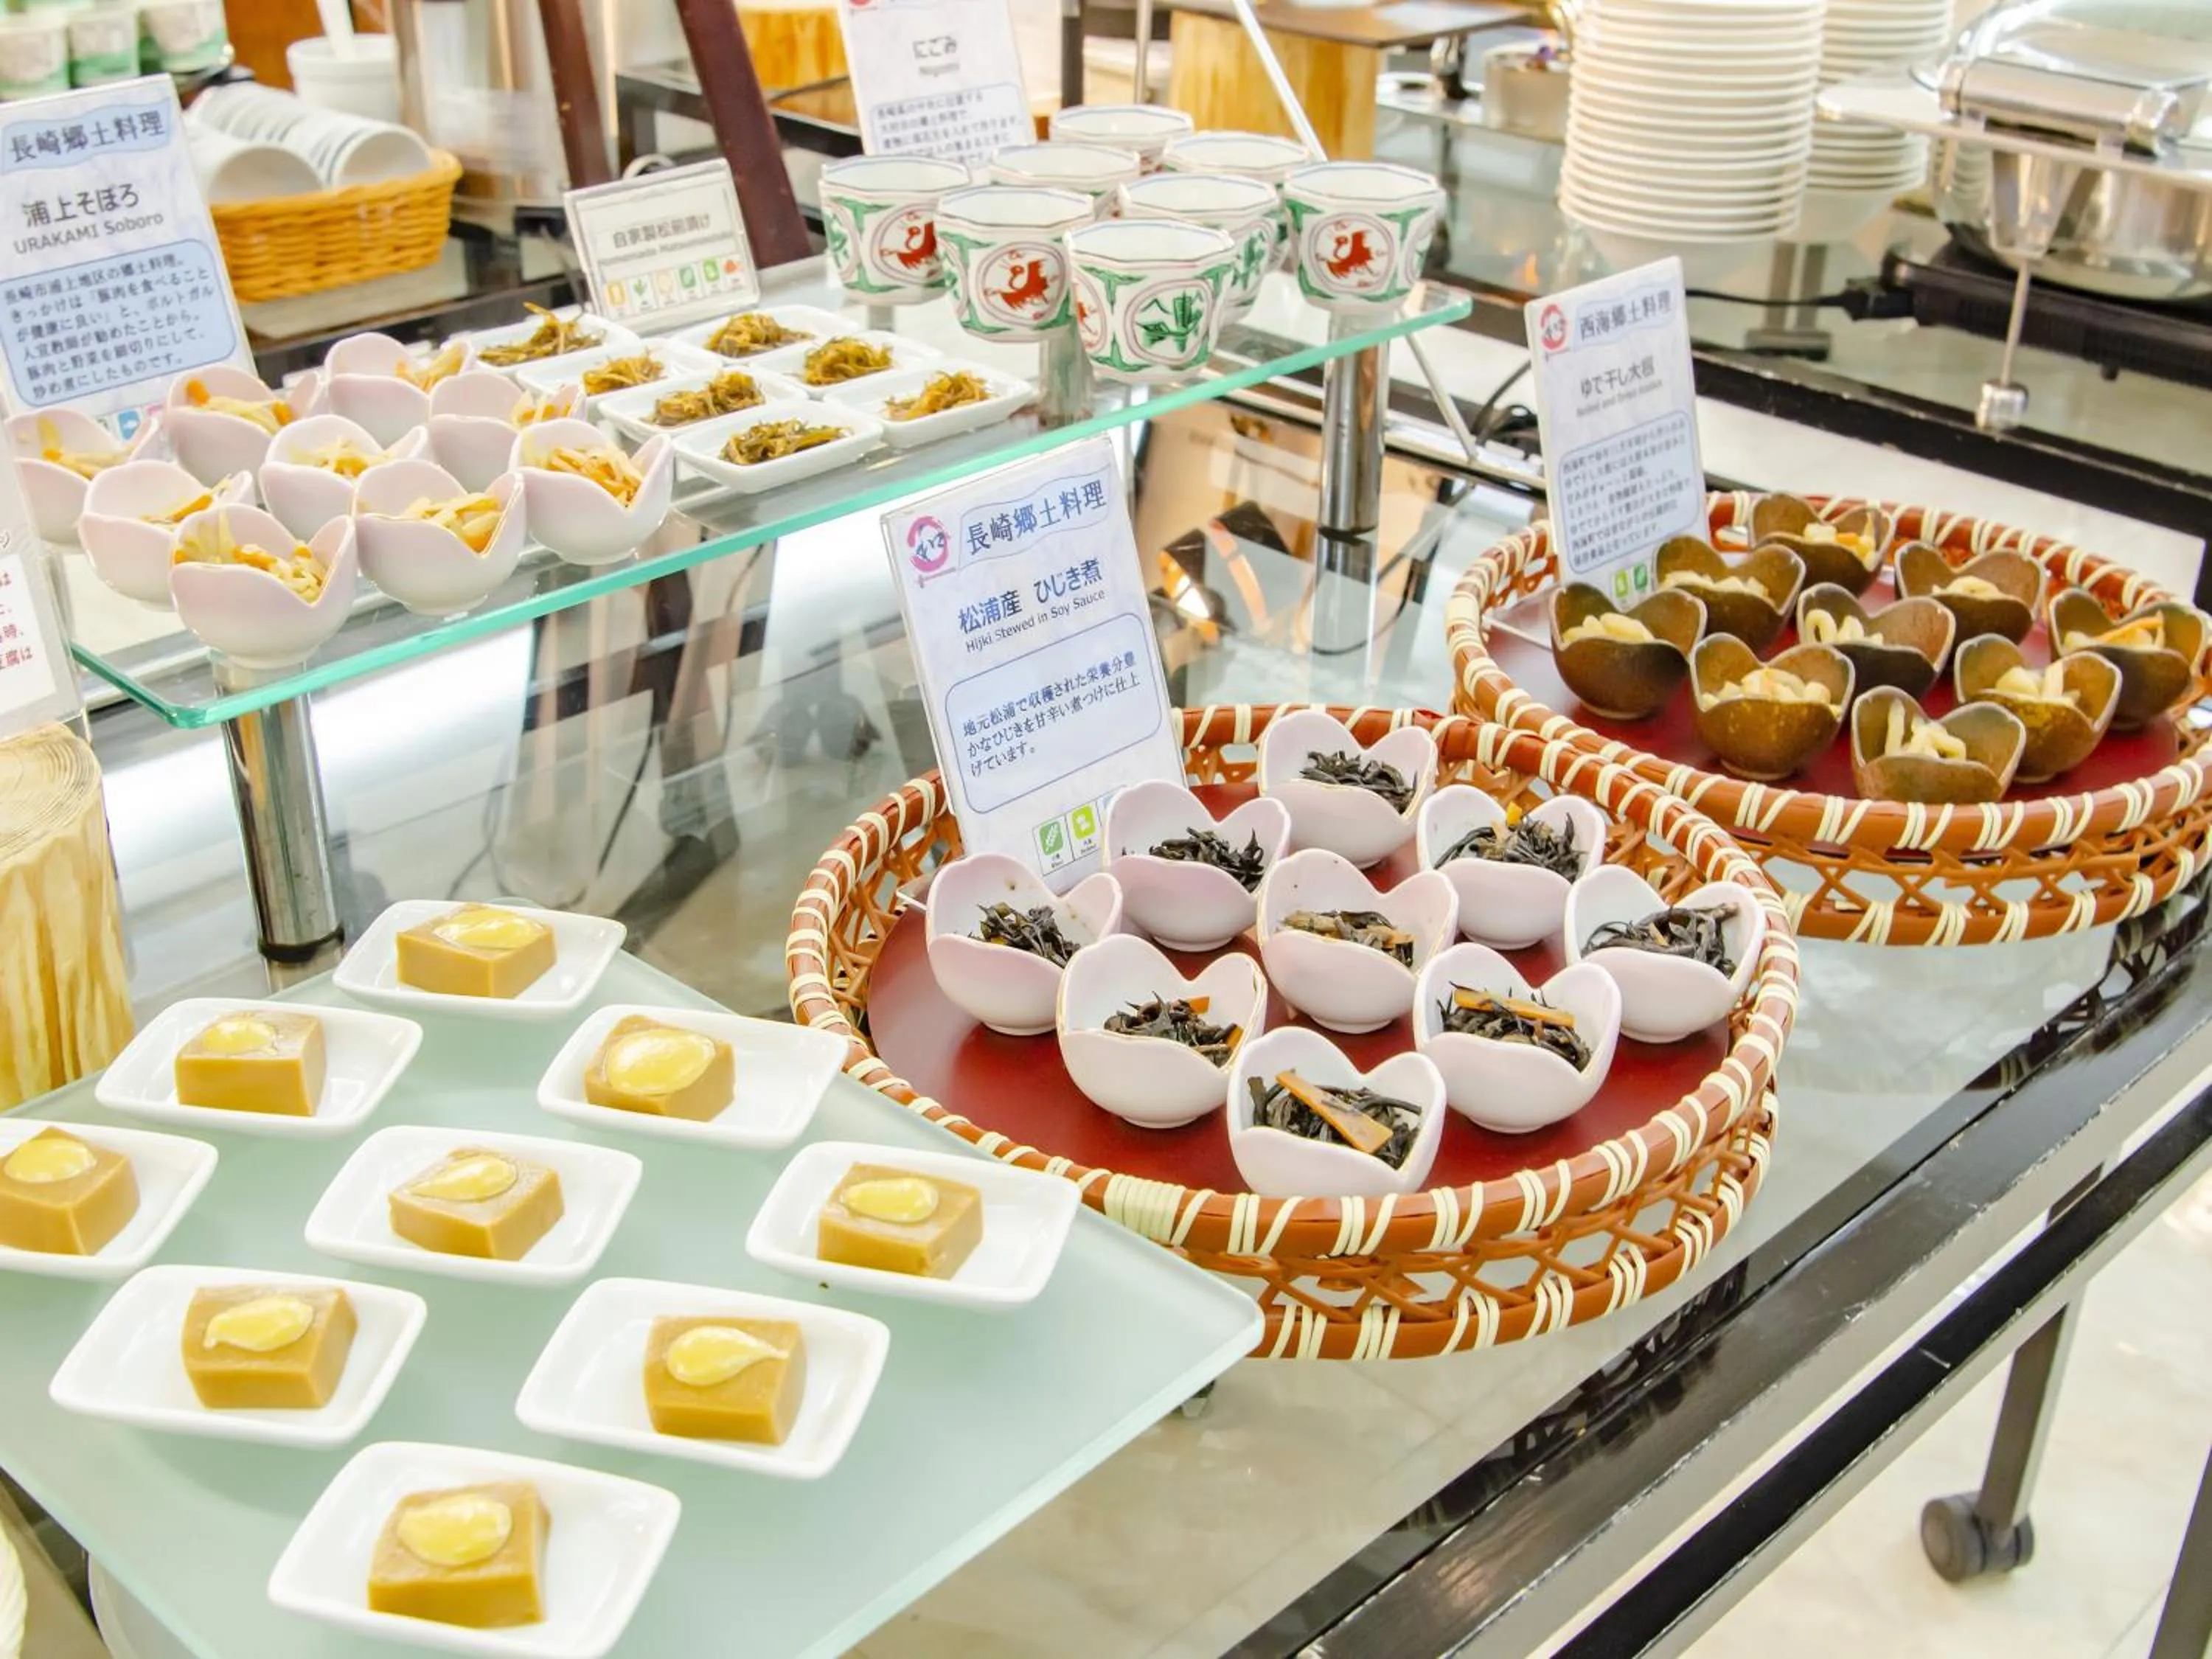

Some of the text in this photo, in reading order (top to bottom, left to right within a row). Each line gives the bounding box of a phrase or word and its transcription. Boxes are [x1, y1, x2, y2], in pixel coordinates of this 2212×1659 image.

[12, 110, 165, 163] 長崎郷土料理
[21, 184, 139, 228] 浦上そぼろ
[13, 212, 164, 254] URAKAMI Soboro
[1580, 290, 1672, 341] 西海郷土料理
[1580, 355, 1655, 398] ゆで干し大根
[967, 479, 1107, 554] 長崎郷土料理
[959, 557, 1103, 633] 松浦産 ひじき煮
[995, 615, 1035, 641] Stewed
[1037, 612, 1048, 624] in
[1050, 602, 1070, 619] Soy
[1073, 589, 1106, 610] Sauce
[963, 650, 1138, 737] 地元松浦で収穫された栄養分豊
[967, 671, 1141, 758] かなひじきを甘辛い煮つけに仕上
[970, 741, 1035, 777] げています。
